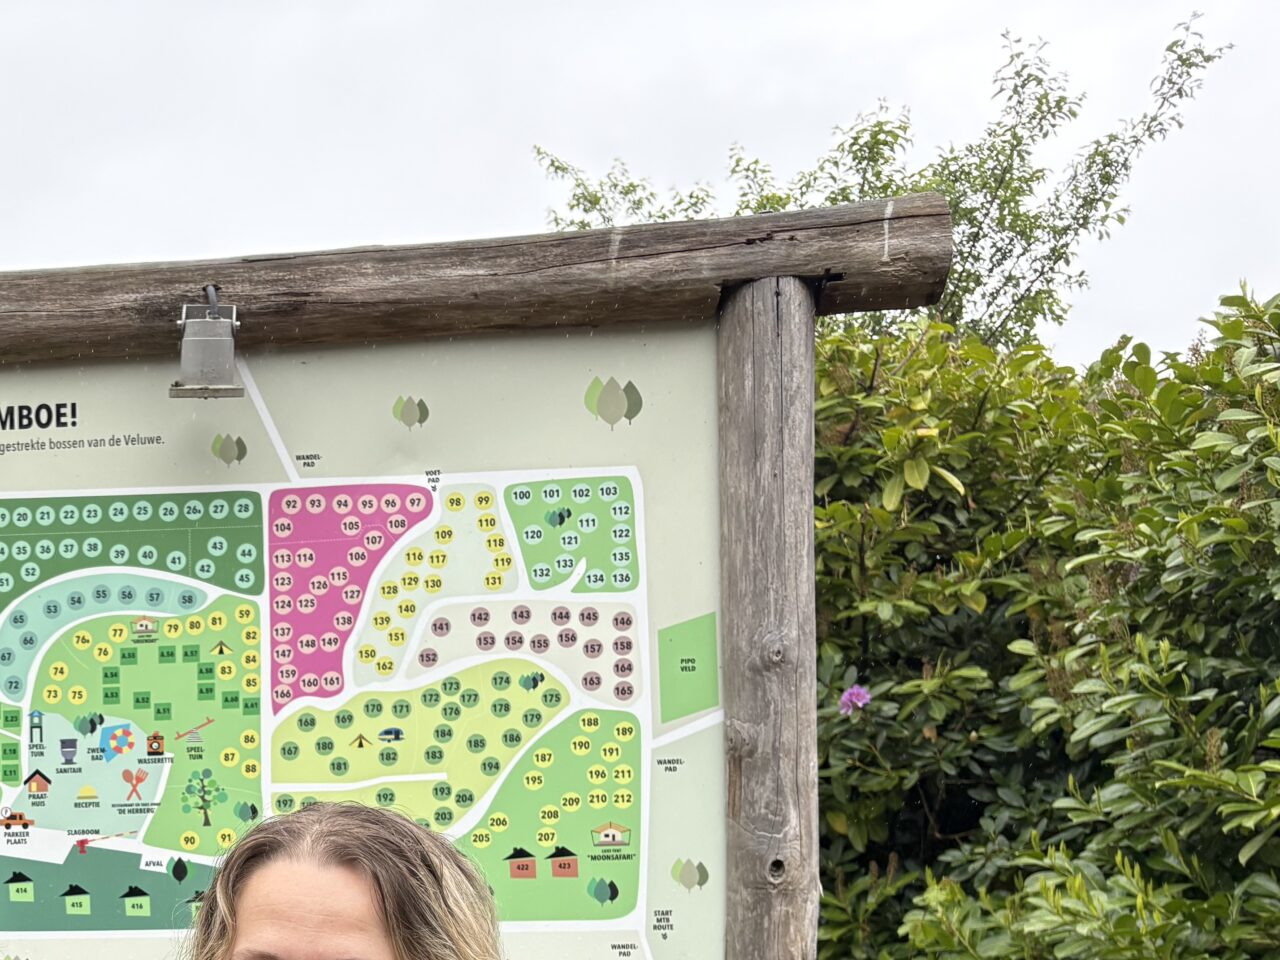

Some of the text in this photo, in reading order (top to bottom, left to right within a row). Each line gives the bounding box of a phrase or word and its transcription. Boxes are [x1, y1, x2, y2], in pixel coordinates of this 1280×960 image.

[48, 438, 85, 450] bossen
[87, 438, 106, 448] van
[108, 435, 122, 447] de
[123, 433, 165, 446] Veluwe.
[573, 488, 590, 498] 102
[286, 500, 297, 509] 92
[336, 500, 348, 508] 94
[410, 498, 421, 507] 97
[449, 498, 461, 507] 98
[136, 506, 148, 516] 25
[238, 504, 249, 513] 28
[612, 506, 630, 515] 112
[17, 512, 28, 522] 20
[63, 510, 75, 519] 22
[343, 521, 360, 531] 105
[436, 530, 453, 539] 109
[524, 530, 542, 540] 120
[64, 544, 74, 553] 37
[114, 549, 125, 559] 39
[612, 552, 630, 562] 135
[274, 554, 292, 564] 113
[430, 555, 446, 564] 117
[200, 564, 211, 573] 42
[239, 574, 250, 583] 45
[330, 571, 348, 581] 115
[587, 574, 604, 584] 134
[311, 581, 328, 590] 126
[485, 576, 501, 586] 131
[381, 585, 398, 595] 128
[71, 596, 82, 605] 54
[149, 593, 160, 602] 57
[298, 599, 315, 608] 125
[239, 609, 251, 618] 59
[513, 610, 530, 620] 143
[580, 612, 598, 622] 145
[212, 617, 222, 626] 81
[374, 616, 391, 626] 139
[23, 637, 34, 645] 66
[299, 639, 316, 648] 148
[478, 636, 495, 646] 153
[531, 639, 549, 649] 155
[614, 641, 632, 651] 158
[98, 648, 109, 656] 76
[275, 649, 292, 658] 147
[377, 661, 393, 671] 162
[8, 680, 19, 690] 72
[246, 678, 257, 688] 85
[324, 677, 340, 686] 161
[493, 676, 510, 686] 174
[583, 676, 601, 686] 163
[442, 682, 460, 691] 173
[72, 691, 83, 700] 75
[365, 703, 382, 713] 170
[443, 707, 460, 716] 176
[336, 714, 353, 724] 169
[582, 718, 599, 727] 188
[316, 741, 334, 751] 180
[468, 739, 485, 748] 185
[380, 752, 397, 761] 182
[603, 747, 619, 757] 191
[138, 757, 174, 765] WASSERETTE
[224, 753, 235, 762] 87
[525, 776, 542, 785] 195
[434, 786, 451, 796] 193
[562, 797, 580, 807] 209
[614, 794, 632, 803] 212
[435, 812, 453, 821] 203
[490, 818, 507, 827] 206
[221, 833, 231, 842] 91
